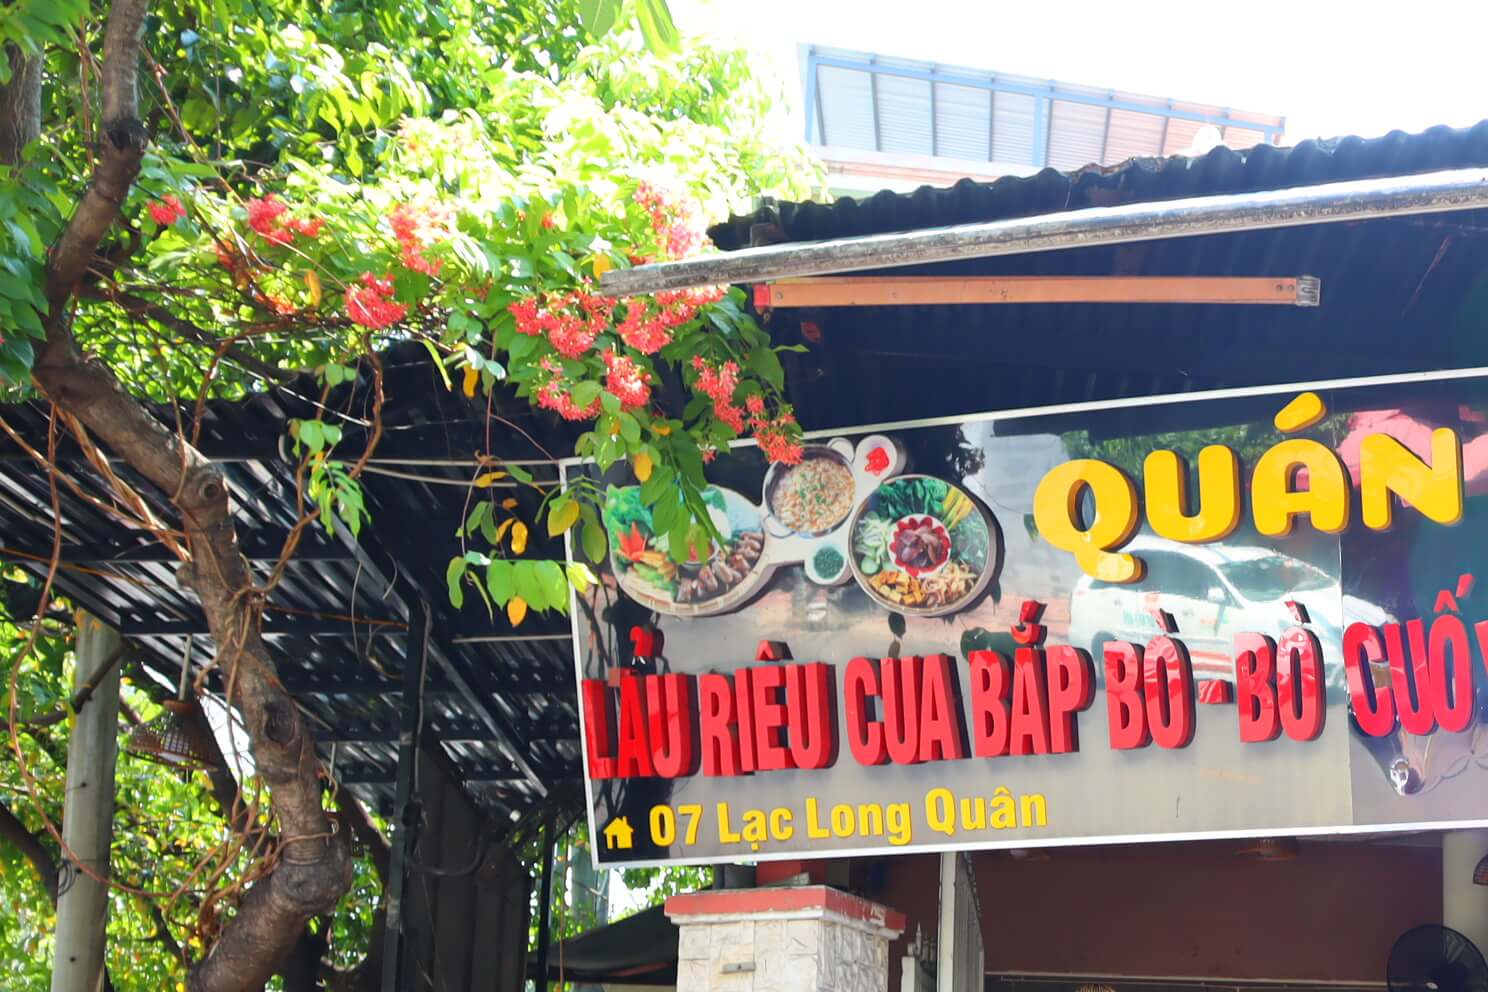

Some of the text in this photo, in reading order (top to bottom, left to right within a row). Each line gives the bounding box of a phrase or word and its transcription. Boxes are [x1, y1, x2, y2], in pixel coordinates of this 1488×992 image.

[1033, 391, 1464, 583] QUÁN
[700, 640, 834, 777] RIÊU
[845, 654, 968, 767] CUA
[968, 600, 1092, 758] BẮP
[1104, 607, 1195, 750] BÒ
[1234, 600, 1326, 744] BÒ
[649, 786, 1048, 853] 07 Lạc Long Quân
